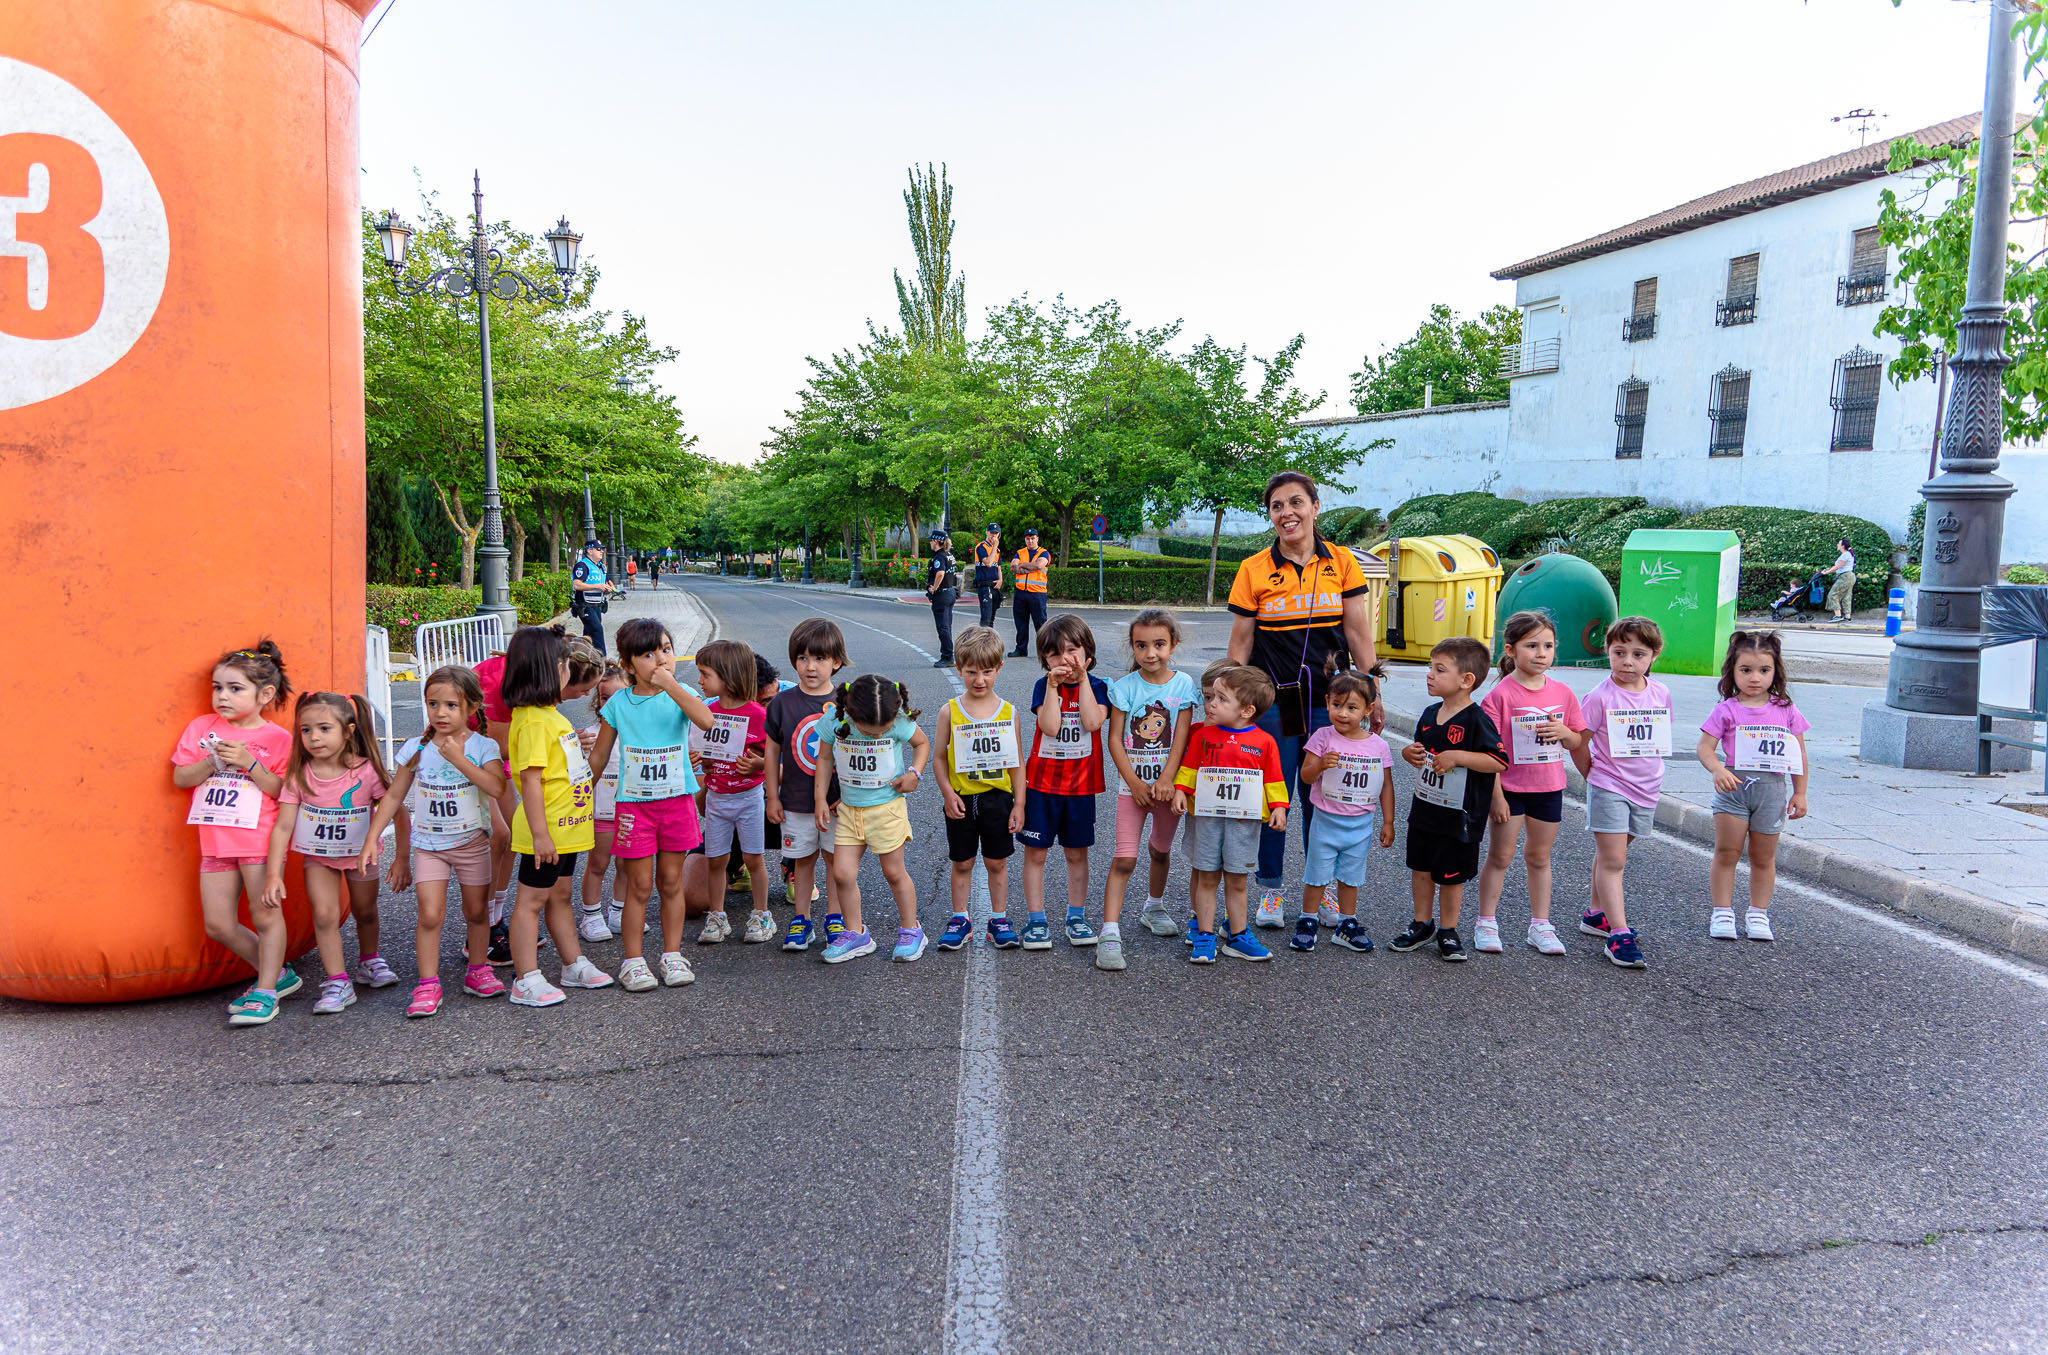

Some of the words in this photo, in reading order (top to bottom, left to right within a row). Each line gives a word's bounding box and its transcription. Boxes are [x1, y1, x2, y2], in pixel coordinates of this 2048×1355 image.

[1265, 597, 1286, 612] e3
[703, 728, 730, 744] 409
[1056, 727, 1080, 742] 406
[1627, 725, 1652, 740] 407
[972, 737, 1001, 754] 405
[1758, 740, 1785, 756] 412
[849, 755, 877, 772] 403
[640, 764, 667, 781] 414
[1135, 764, 1161, 780] 408
[1342, 771, 1368, 788] 410
[1421, 768, 1444, 789] 401
[204, 788, 239, 807] 402
[1216, 783, 1241, 801] 417
[429, 800, 458, 817] 416
[558, 817, 566, 827] El
[314, 824, 346, 840] 415
